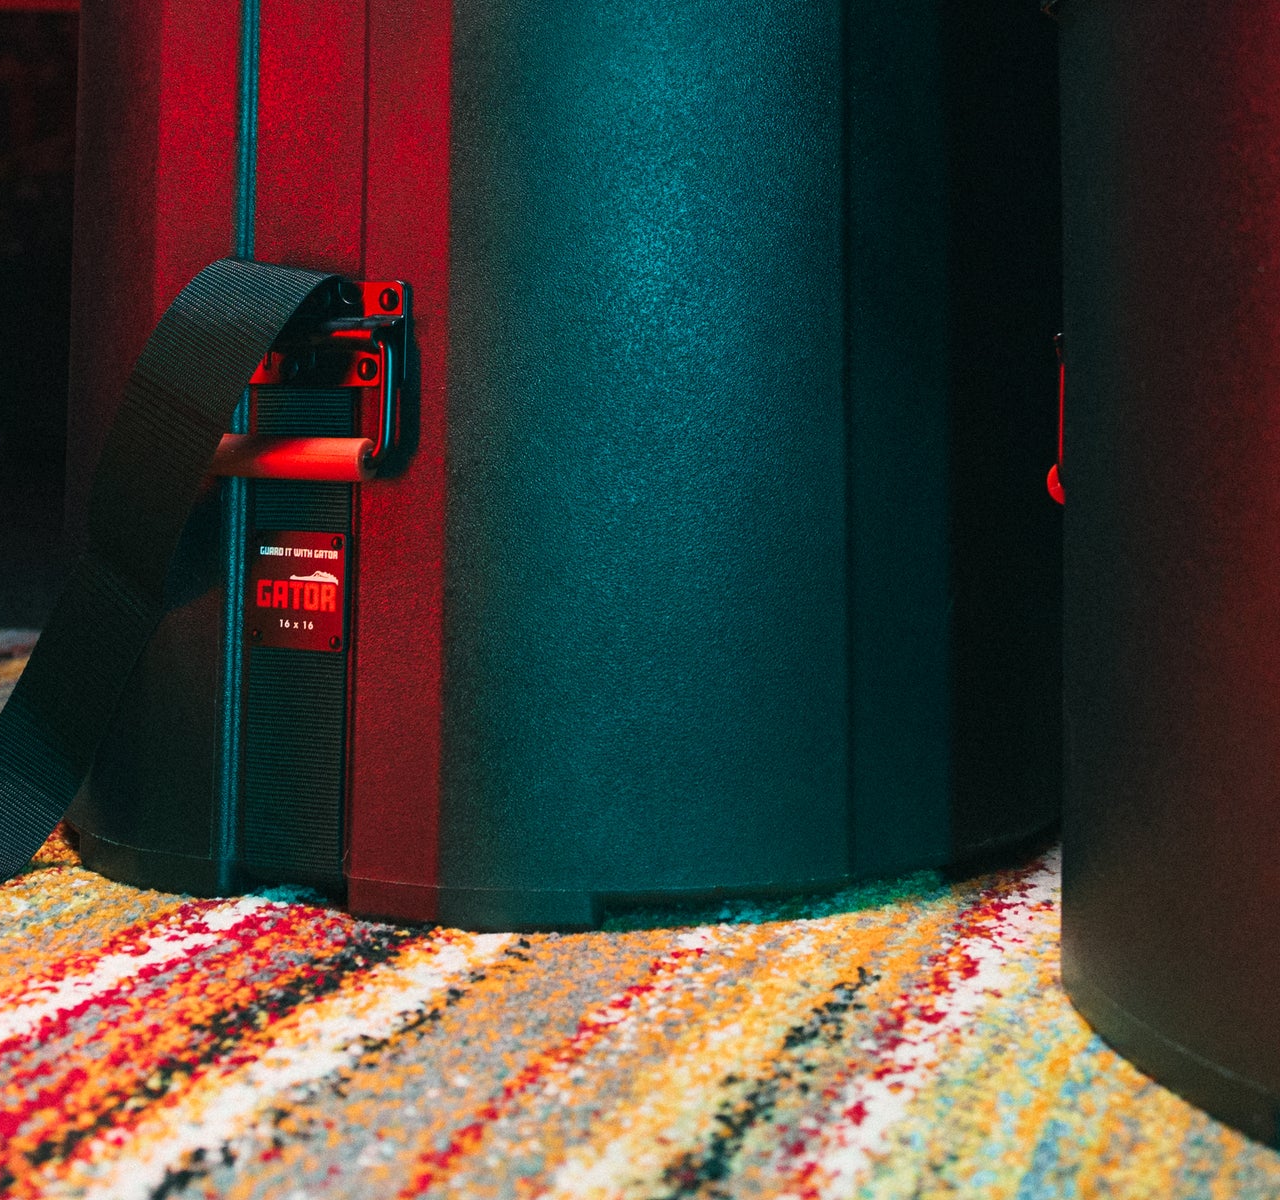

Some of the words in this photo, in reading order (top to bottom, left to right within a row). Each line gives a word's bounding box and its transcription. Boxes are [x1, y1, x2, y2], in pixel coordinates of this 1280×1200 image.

[260, 545, 284, 557] GUARD
[285, 546, 293, 557] IT
[293, 548, 313, 558] WITH
[314, 548, 339, 560] GATOR
[256, 578, 338, 613] GATOR
[279, 618, 291, 629] 16
[292, 621, 299, 629] x
[302, 620, 314, 631] 16
